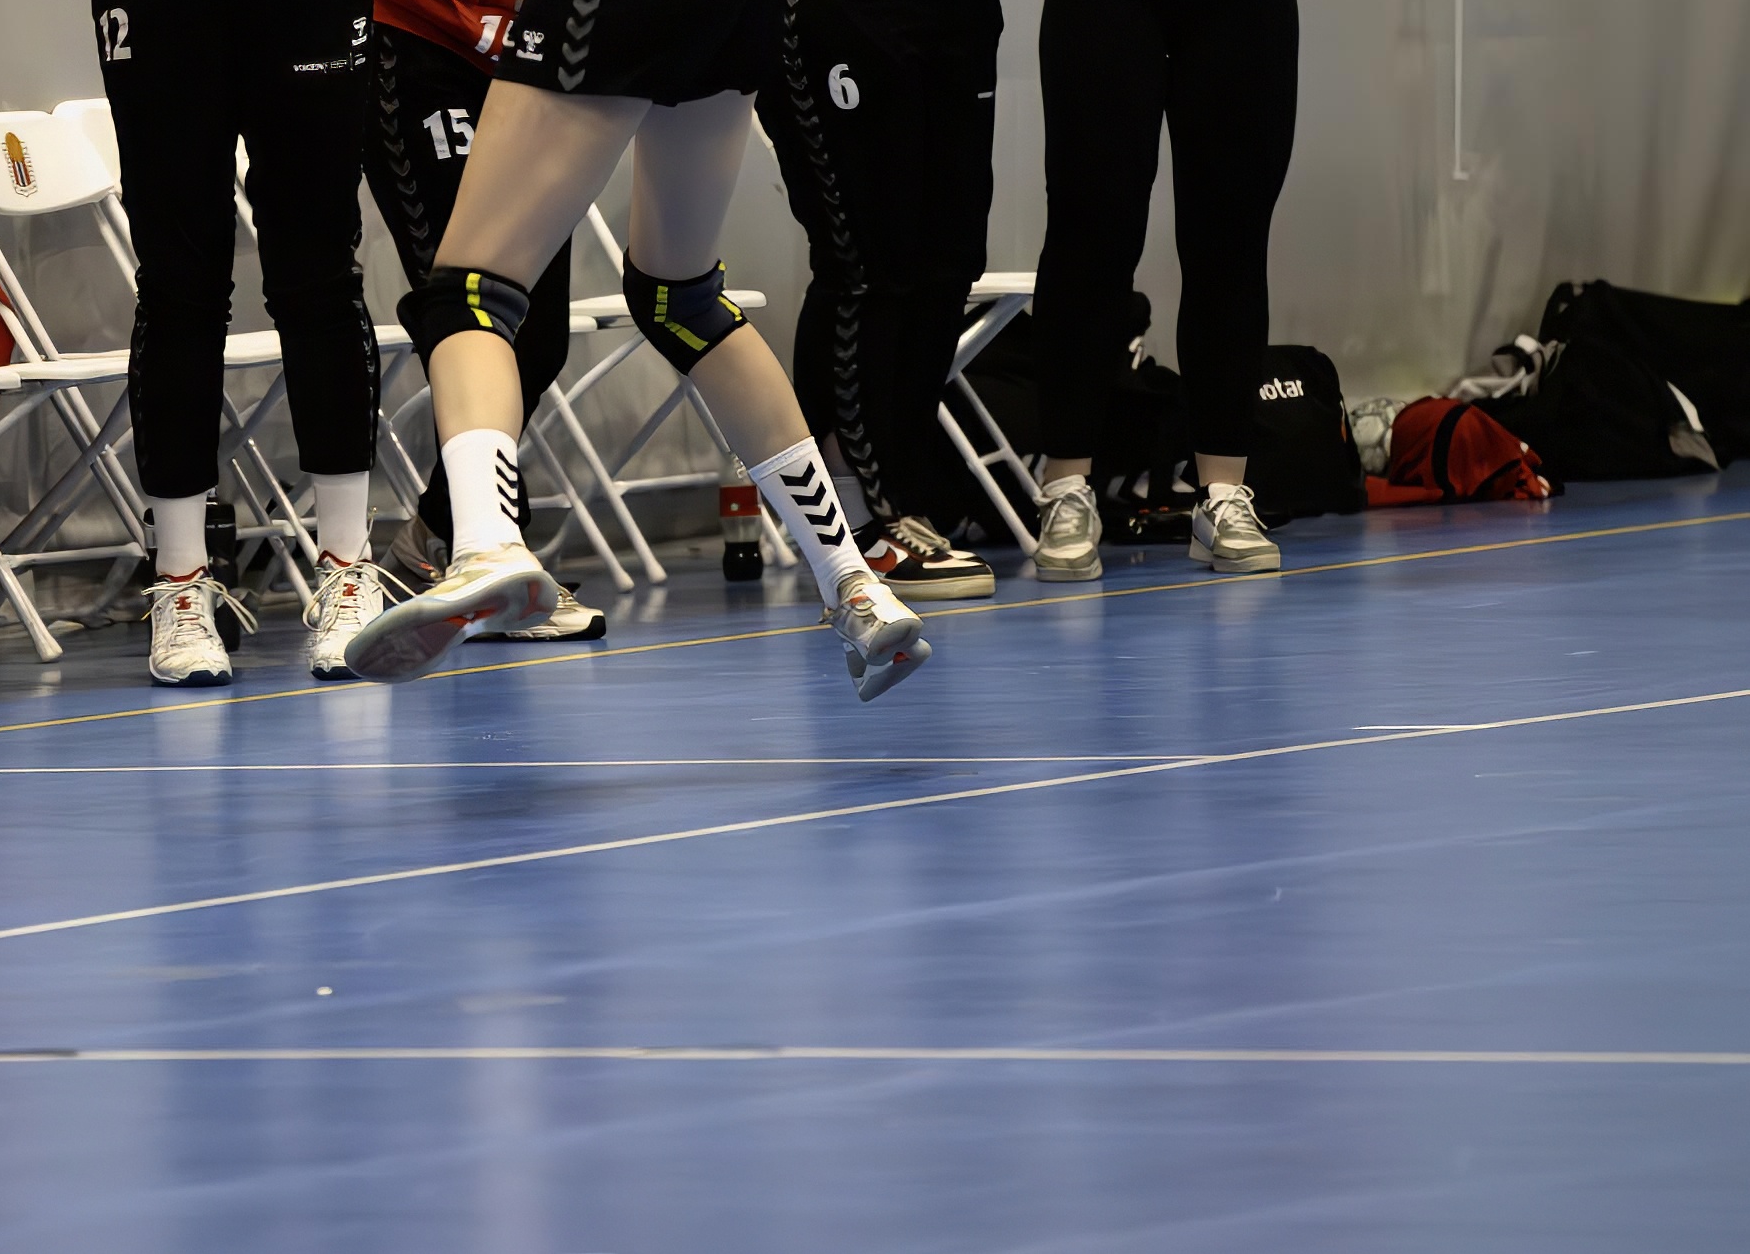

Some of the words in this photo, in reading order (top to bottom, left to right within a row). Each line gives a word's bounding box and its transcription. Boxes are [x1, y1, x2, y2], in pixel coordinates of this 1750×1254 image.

[99, 7, 132, 62] 12
[828, 63, 860, 110] 6
[422, 108, 475, 160] 15
